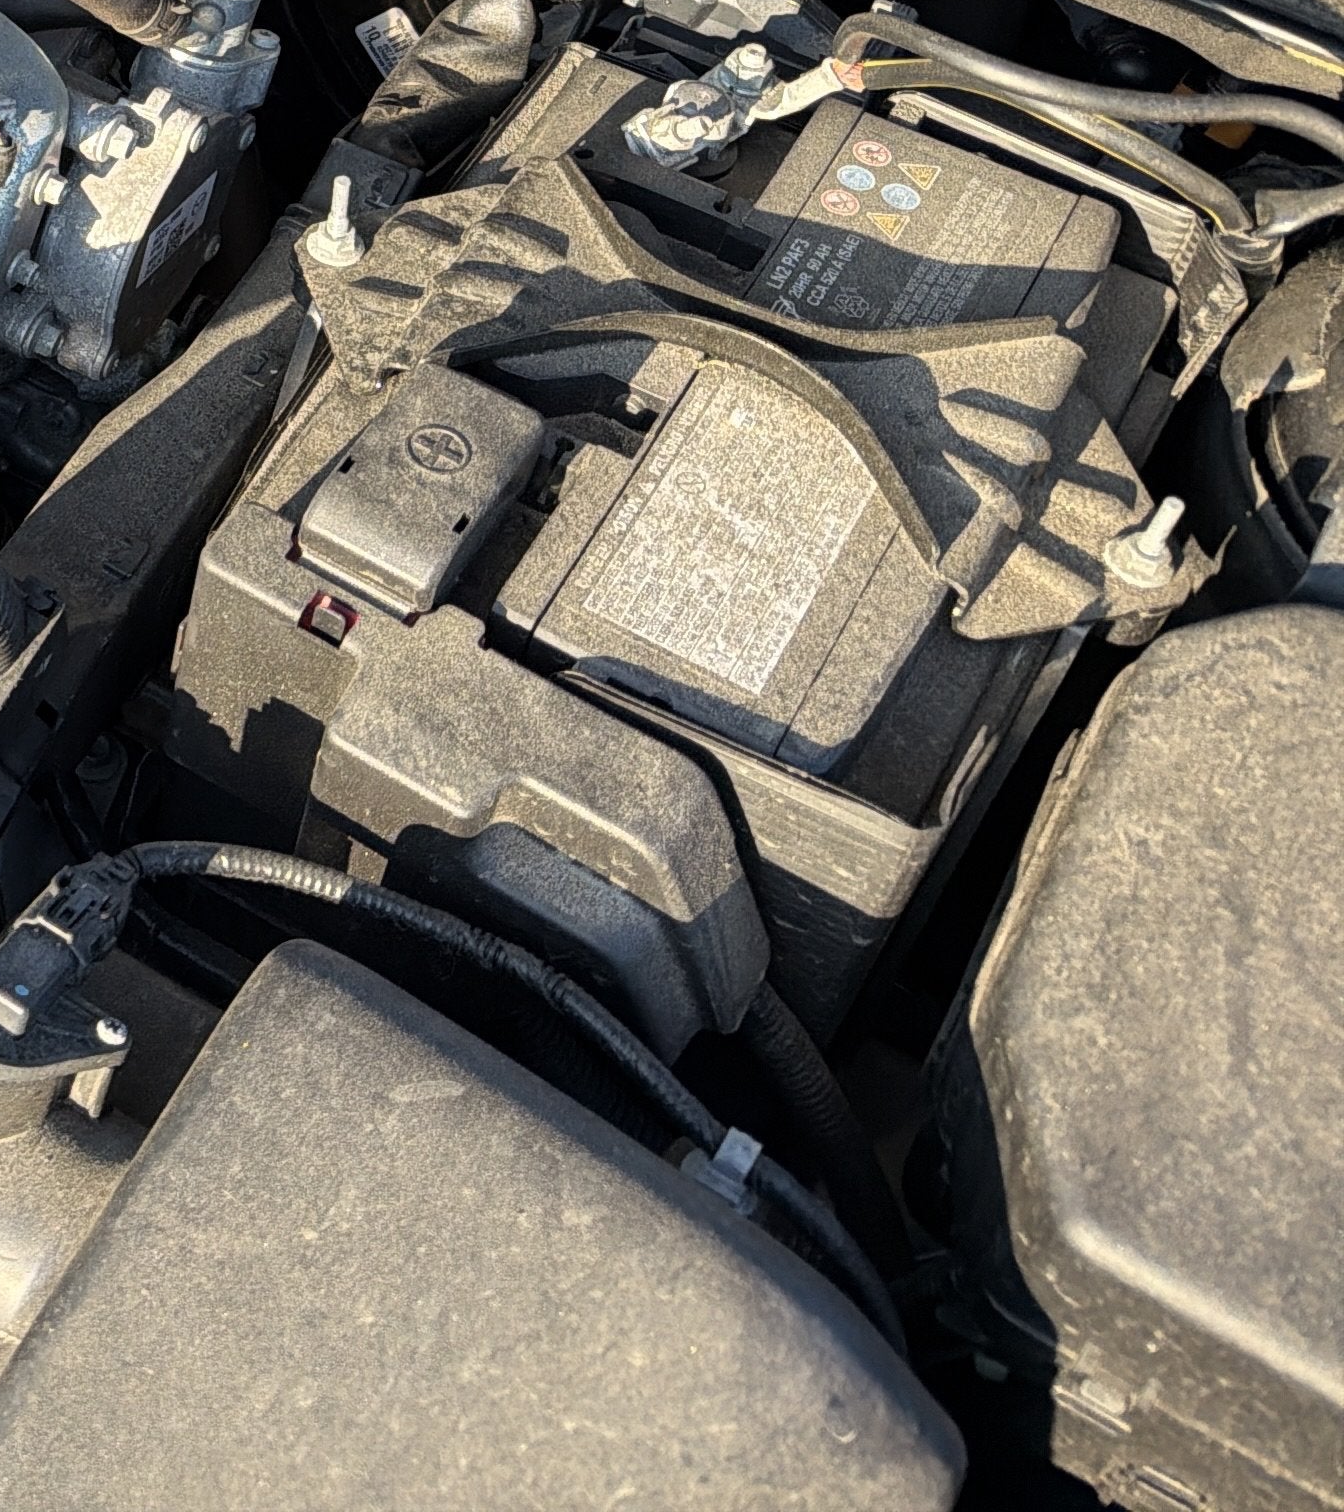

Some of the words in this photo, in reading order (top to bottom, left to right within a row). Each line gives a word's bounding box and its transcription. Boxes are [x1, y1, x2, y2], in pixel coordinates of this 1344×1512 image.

[766, 264, 792, 291] LN2
[782, 237, 811, 268] PAF3
[789, 271, 814, 299] 20HR
[814, 242, 833, 261] AH
[806, 283, 829, 307] CCA
[820, 266, 840, 286] 520
